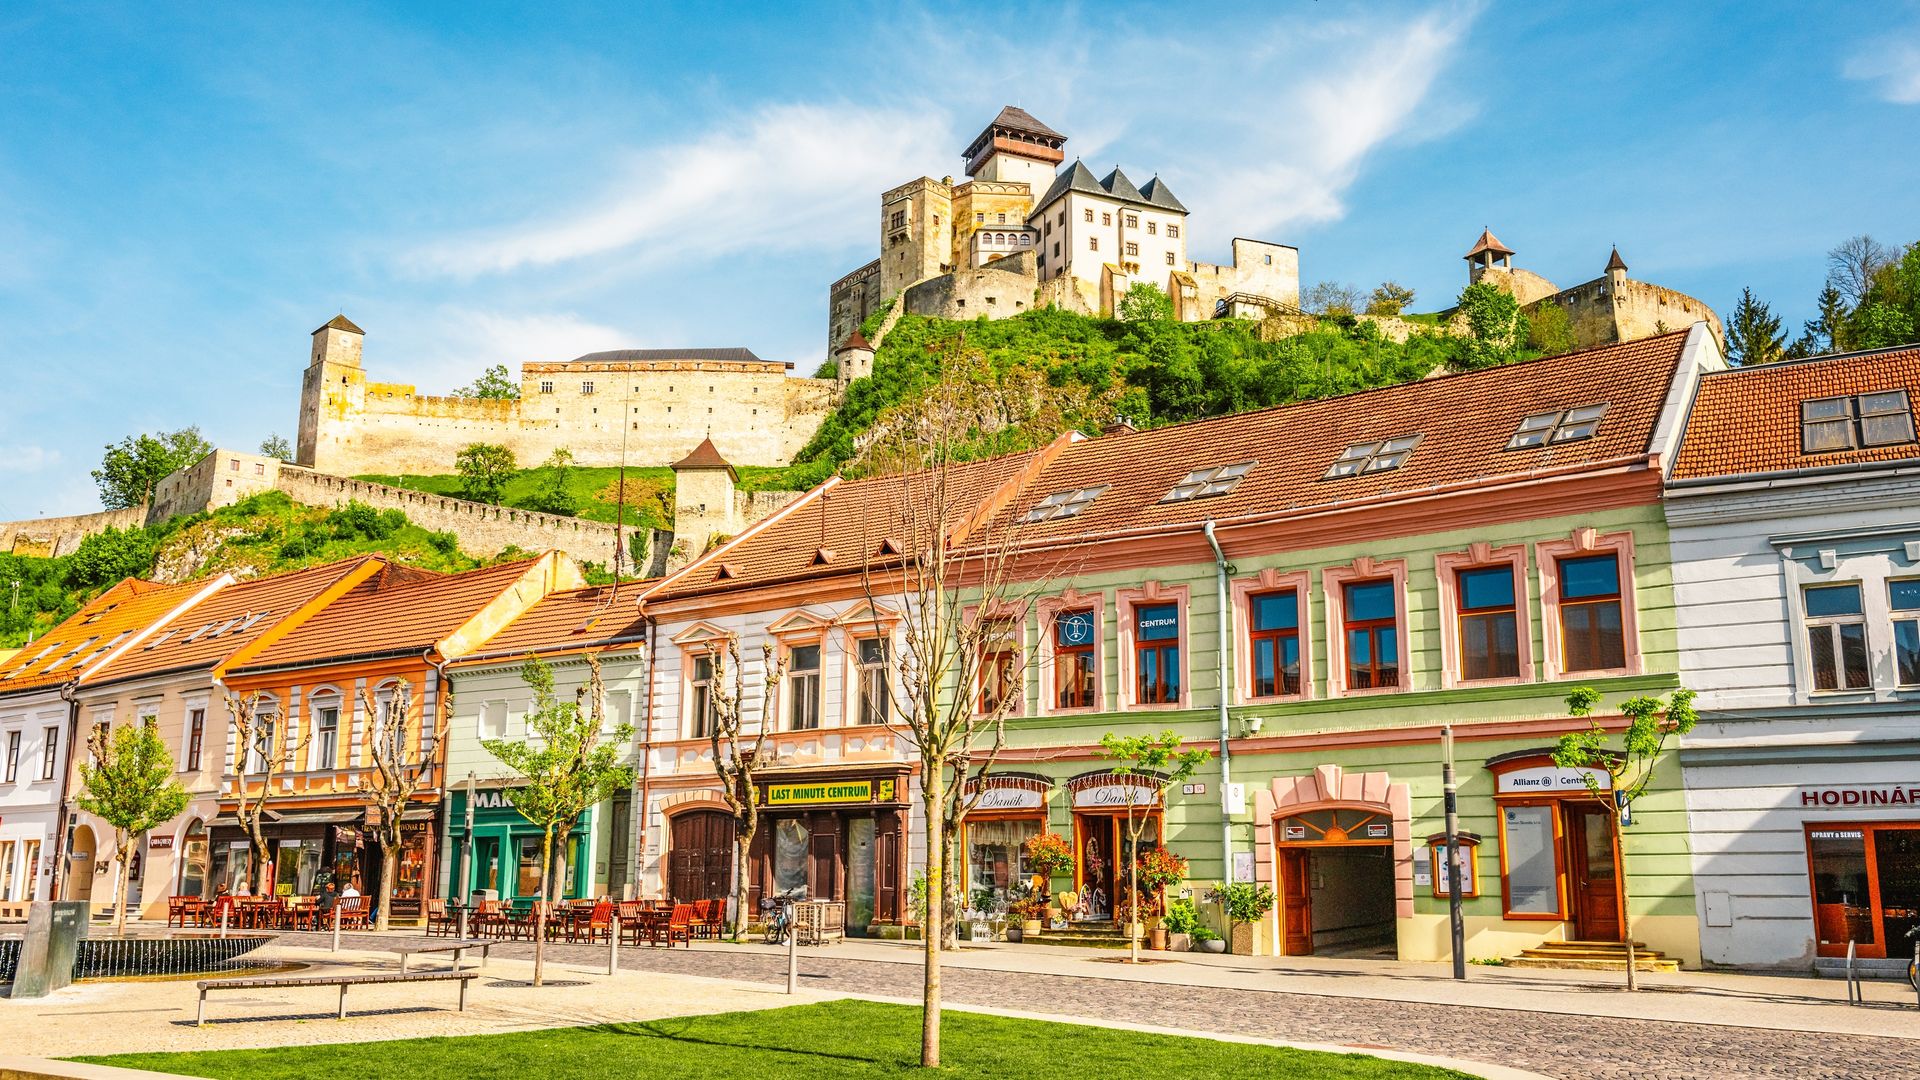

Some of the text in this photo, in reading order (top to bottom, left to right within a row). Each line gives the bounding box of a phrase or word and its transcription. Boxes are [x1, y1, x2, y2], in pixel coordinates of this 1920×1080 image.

[1140, 618, 1176, 628] CENTRUM
[1513, 778, 1540, 786] Allianz
[771, 785, 868, 800] LAST MINUTE CENTRUM
